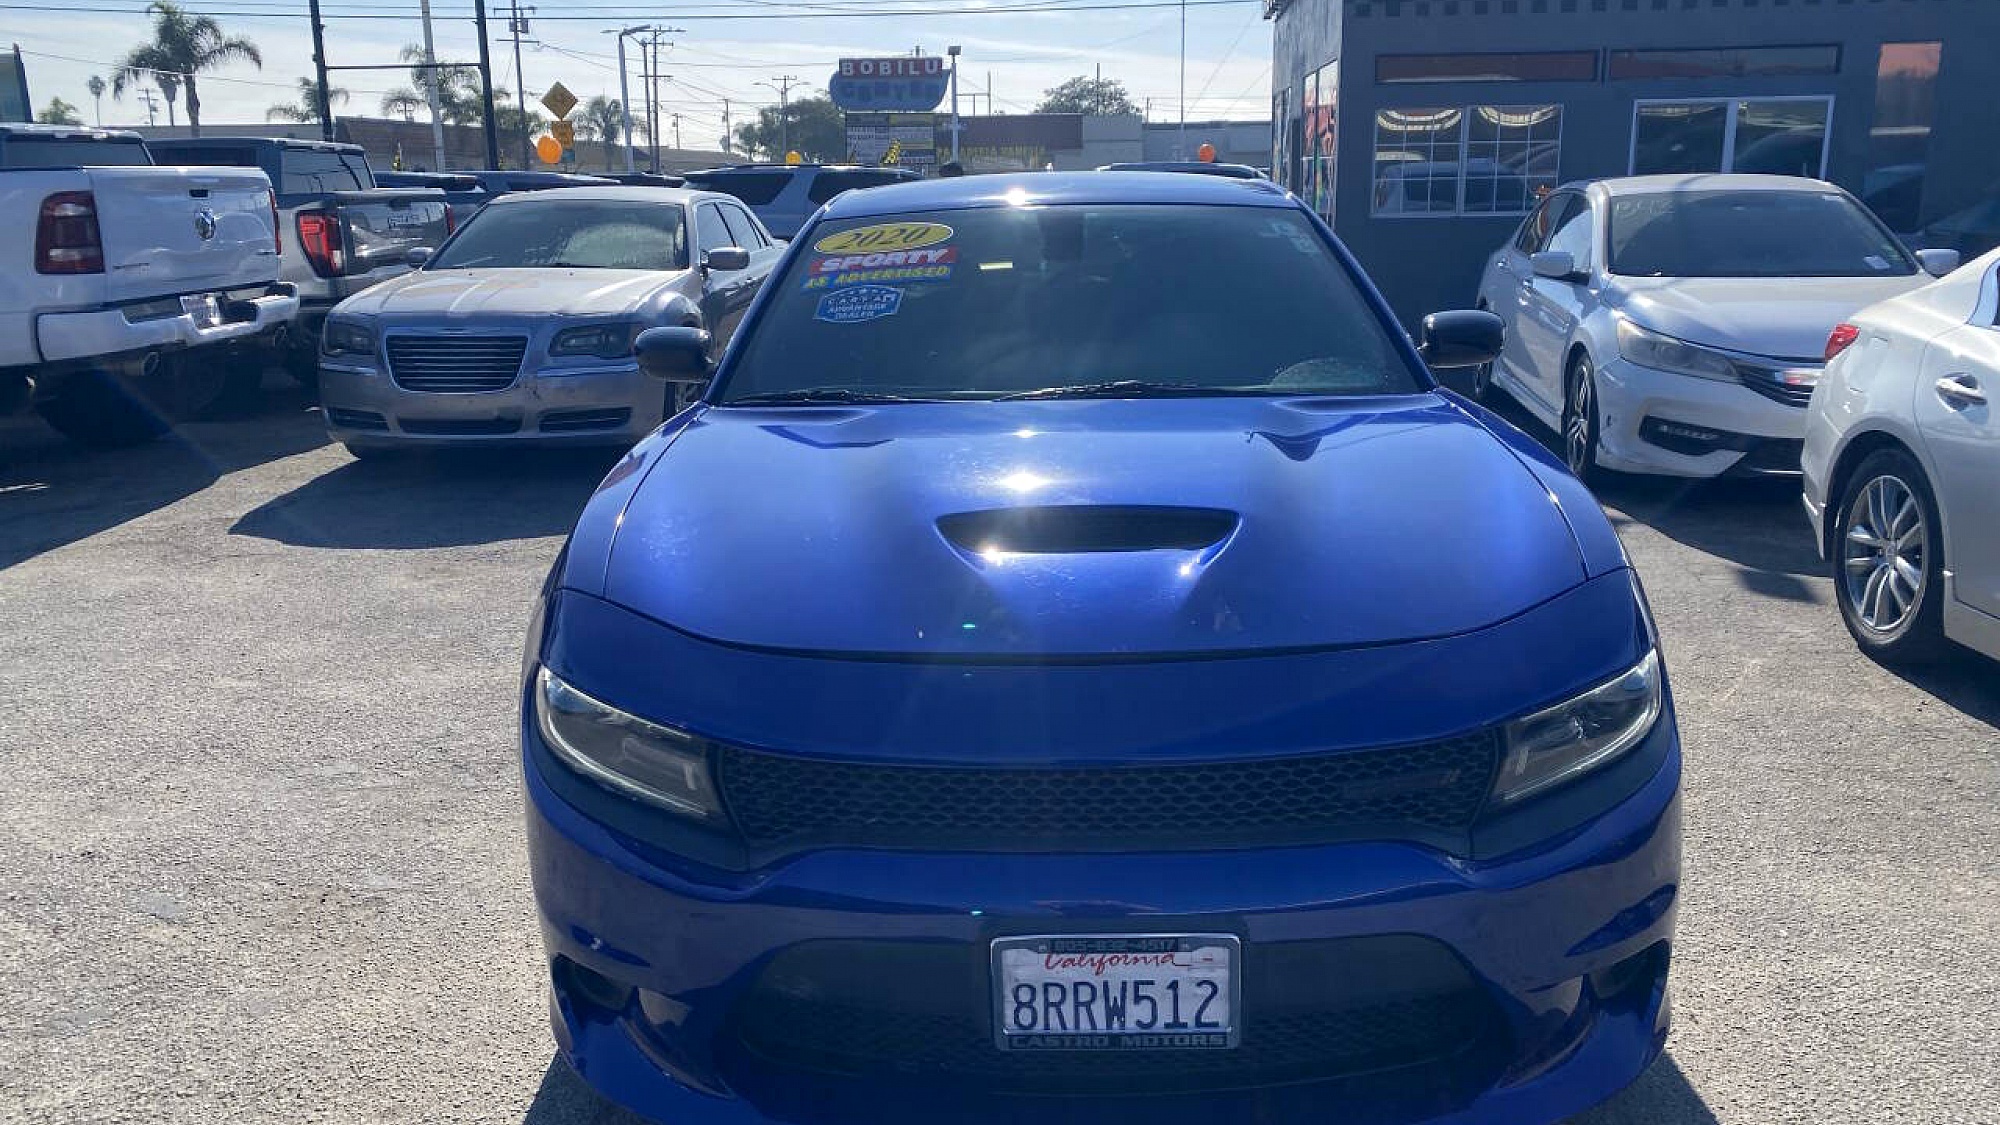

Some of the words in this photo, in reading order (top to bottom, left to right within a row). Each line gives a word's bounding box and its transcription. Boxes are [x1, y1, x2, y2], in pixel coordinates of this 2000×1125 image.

[841, 59, 938, 75] BOBILU
[833, 225, 933, 250] 2020
[819, 247, 950, 272] SPORTY
[836, 265, 951, 285] ADVERTISED
[1045, 952, 1192, 976] California
[1012, 979, 1221, 1031] 8RRW512
[1013, 1035, 1109, 1048] CASTRO
[1122, 1034, 1228, 1047] MOTORS
